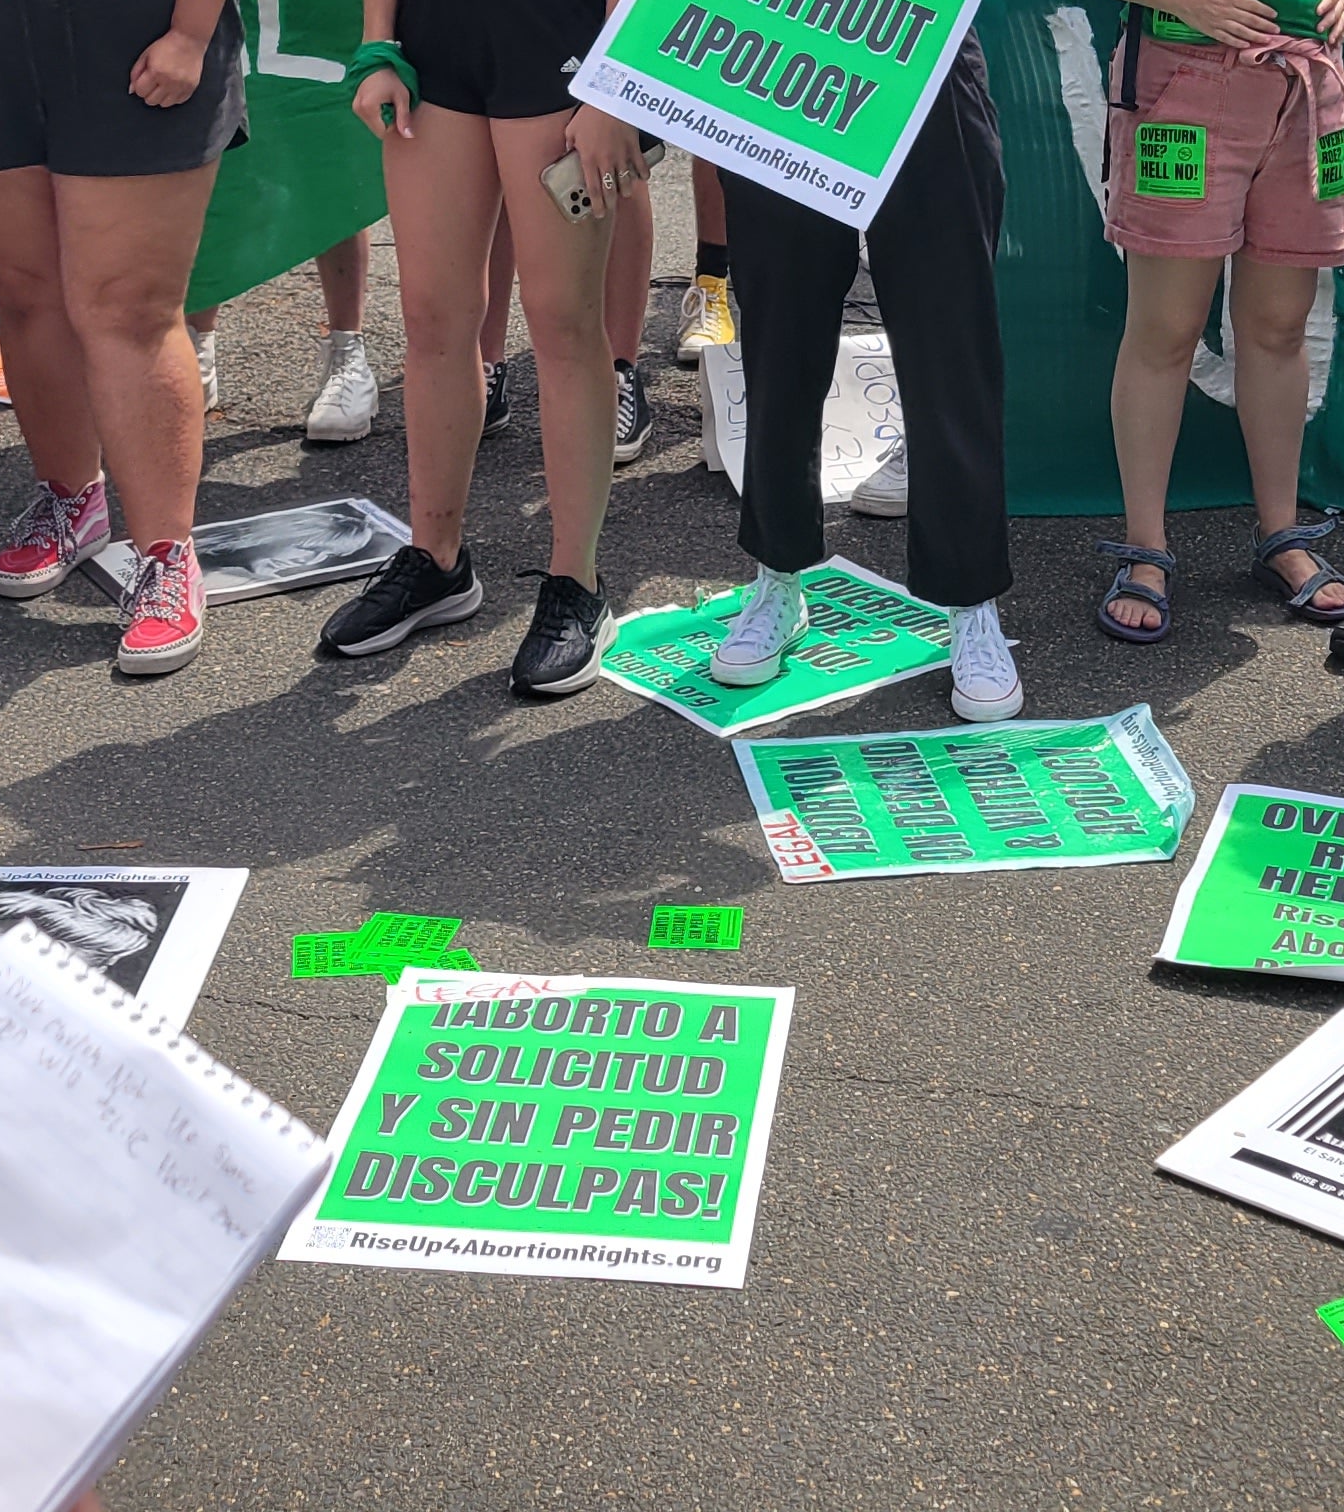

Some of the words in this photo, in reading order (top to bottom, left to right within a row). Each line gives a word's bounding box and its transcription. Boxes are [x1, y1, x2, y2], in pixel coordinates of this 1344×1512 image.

[658, 3, 881, 137] APOLOGY
[620, 78, 867, 209] RiseUp4AbortionRights.org
[1140, 126, 1197, 145] OVERTURN
[1140, 144, 1168, 159] ROE?
[1140, 162, 1170, 181] HELL
[1174, 164, 1199, 182] NO!
[1321, 165, 1344, 185] HELL
[807, 601, 872, 636] ROE
[607, 651, 721, 708] Rights.org
[788, 641, 872, 676] NO!
[776, 754, 881, 856] ABORTION
[858, 741, 958, 829] DEMAND
[942, 743, 1050, 832] WITHOUT
[1030, 746, 1149, 836] APOLOGY
[763, 813, 837, 881] LEGAL
[901, 831, 976, 862] ON
[1005, 833, 1063, 849] &
[415, 975, 571, 1003] LEGAL
[695, 1003, 740, 1043] A
[416, 1040, 727, 1097] SOLICITUD
[379, 1093, 417, 1138] Y
[429, 1097, 537, 1148] SIN
[550, 1106, 738, 1159] PEDIR
[343, 1149, 727, 1221] DISCULPAS!
[1291, 1171, 1319, 1187] RISE
[1319, 1180, 1337, 1193] UP
[350, 1230, 722, 1275] RiseUp4AbortionRights.org
